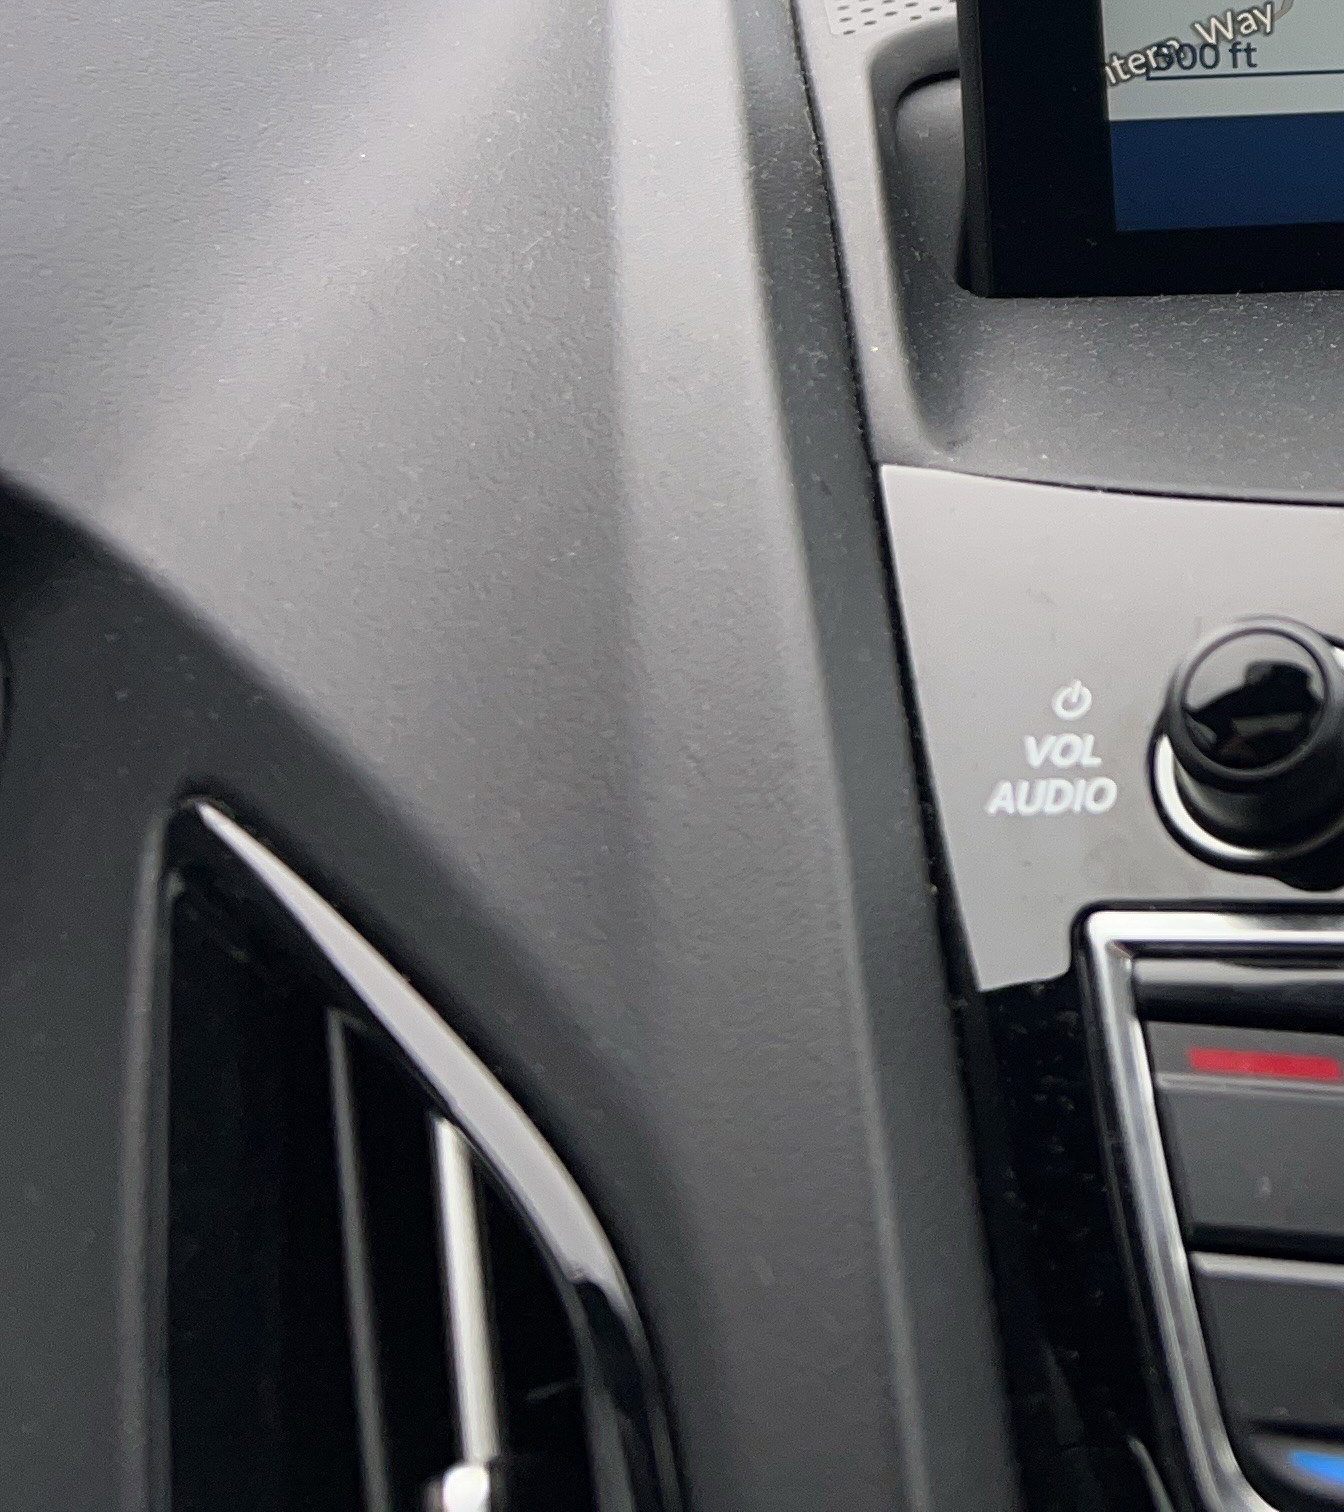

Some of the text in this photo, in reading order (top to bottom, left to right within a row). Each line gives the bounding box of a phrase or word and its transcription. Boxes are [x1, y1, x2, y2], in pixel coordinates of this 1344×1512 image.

[1193, 2, 1273, 45] Way
[1228, 40, 1259, 69] ft
[1023, 733, 1104, 769] VOL
[987, 776, 1118, 815] AUDIO
